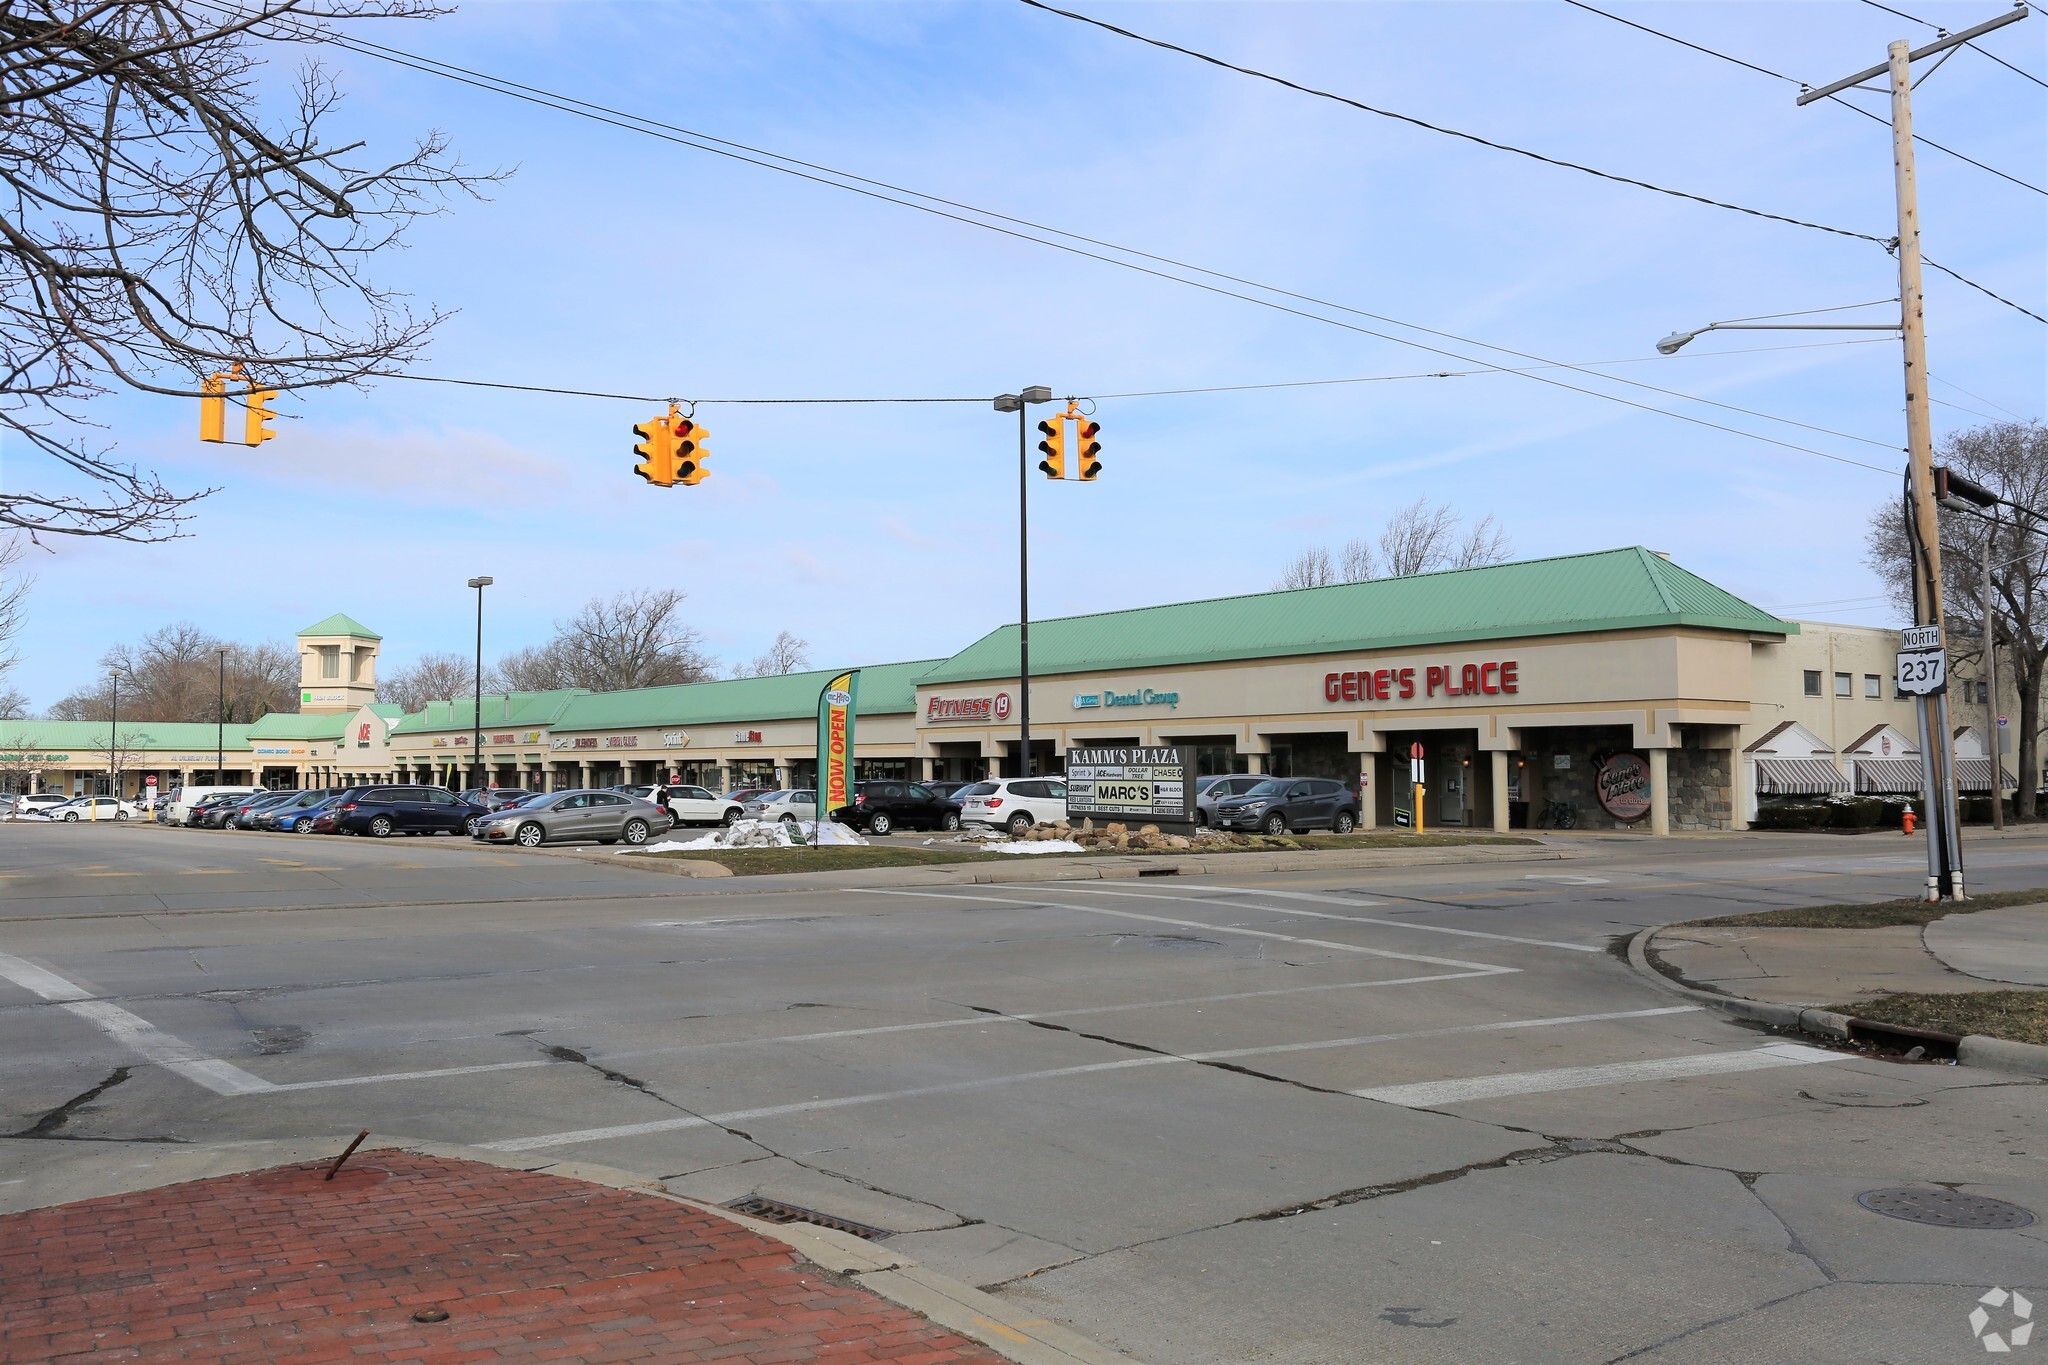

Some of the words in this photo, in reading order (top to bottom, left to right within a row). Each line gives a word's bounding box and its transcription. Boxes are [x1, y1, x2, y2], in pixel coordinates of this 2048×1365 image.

[1904, 631, 1938, 646] NORTH
[1902, 660, 1939, 682] 237
[1325, 667, 1416, 702] GENE'S
[1426, 661, 1519, 697] PLACE
[996, 696, 1008, 713] 19
[1104, 689, 1143, 706] Dental
[1143, 688, 1179, 708] Group
[664, 732, 683, 748] Sprint
[830, 709, 846, 755] OPEN
[1072, 749, 1127, 764] KAMM'S
[1132, 749, 1179, 764] PLAZA
[1071, 768, 1086, 777] Sprint
[1154, 768, 1177, 777] CHASE
[828, 760, 846, 803] NOW
[1068, 784, 1092, 793] SUBWAY
[1098, 785, 1149, 800] MARC'S
